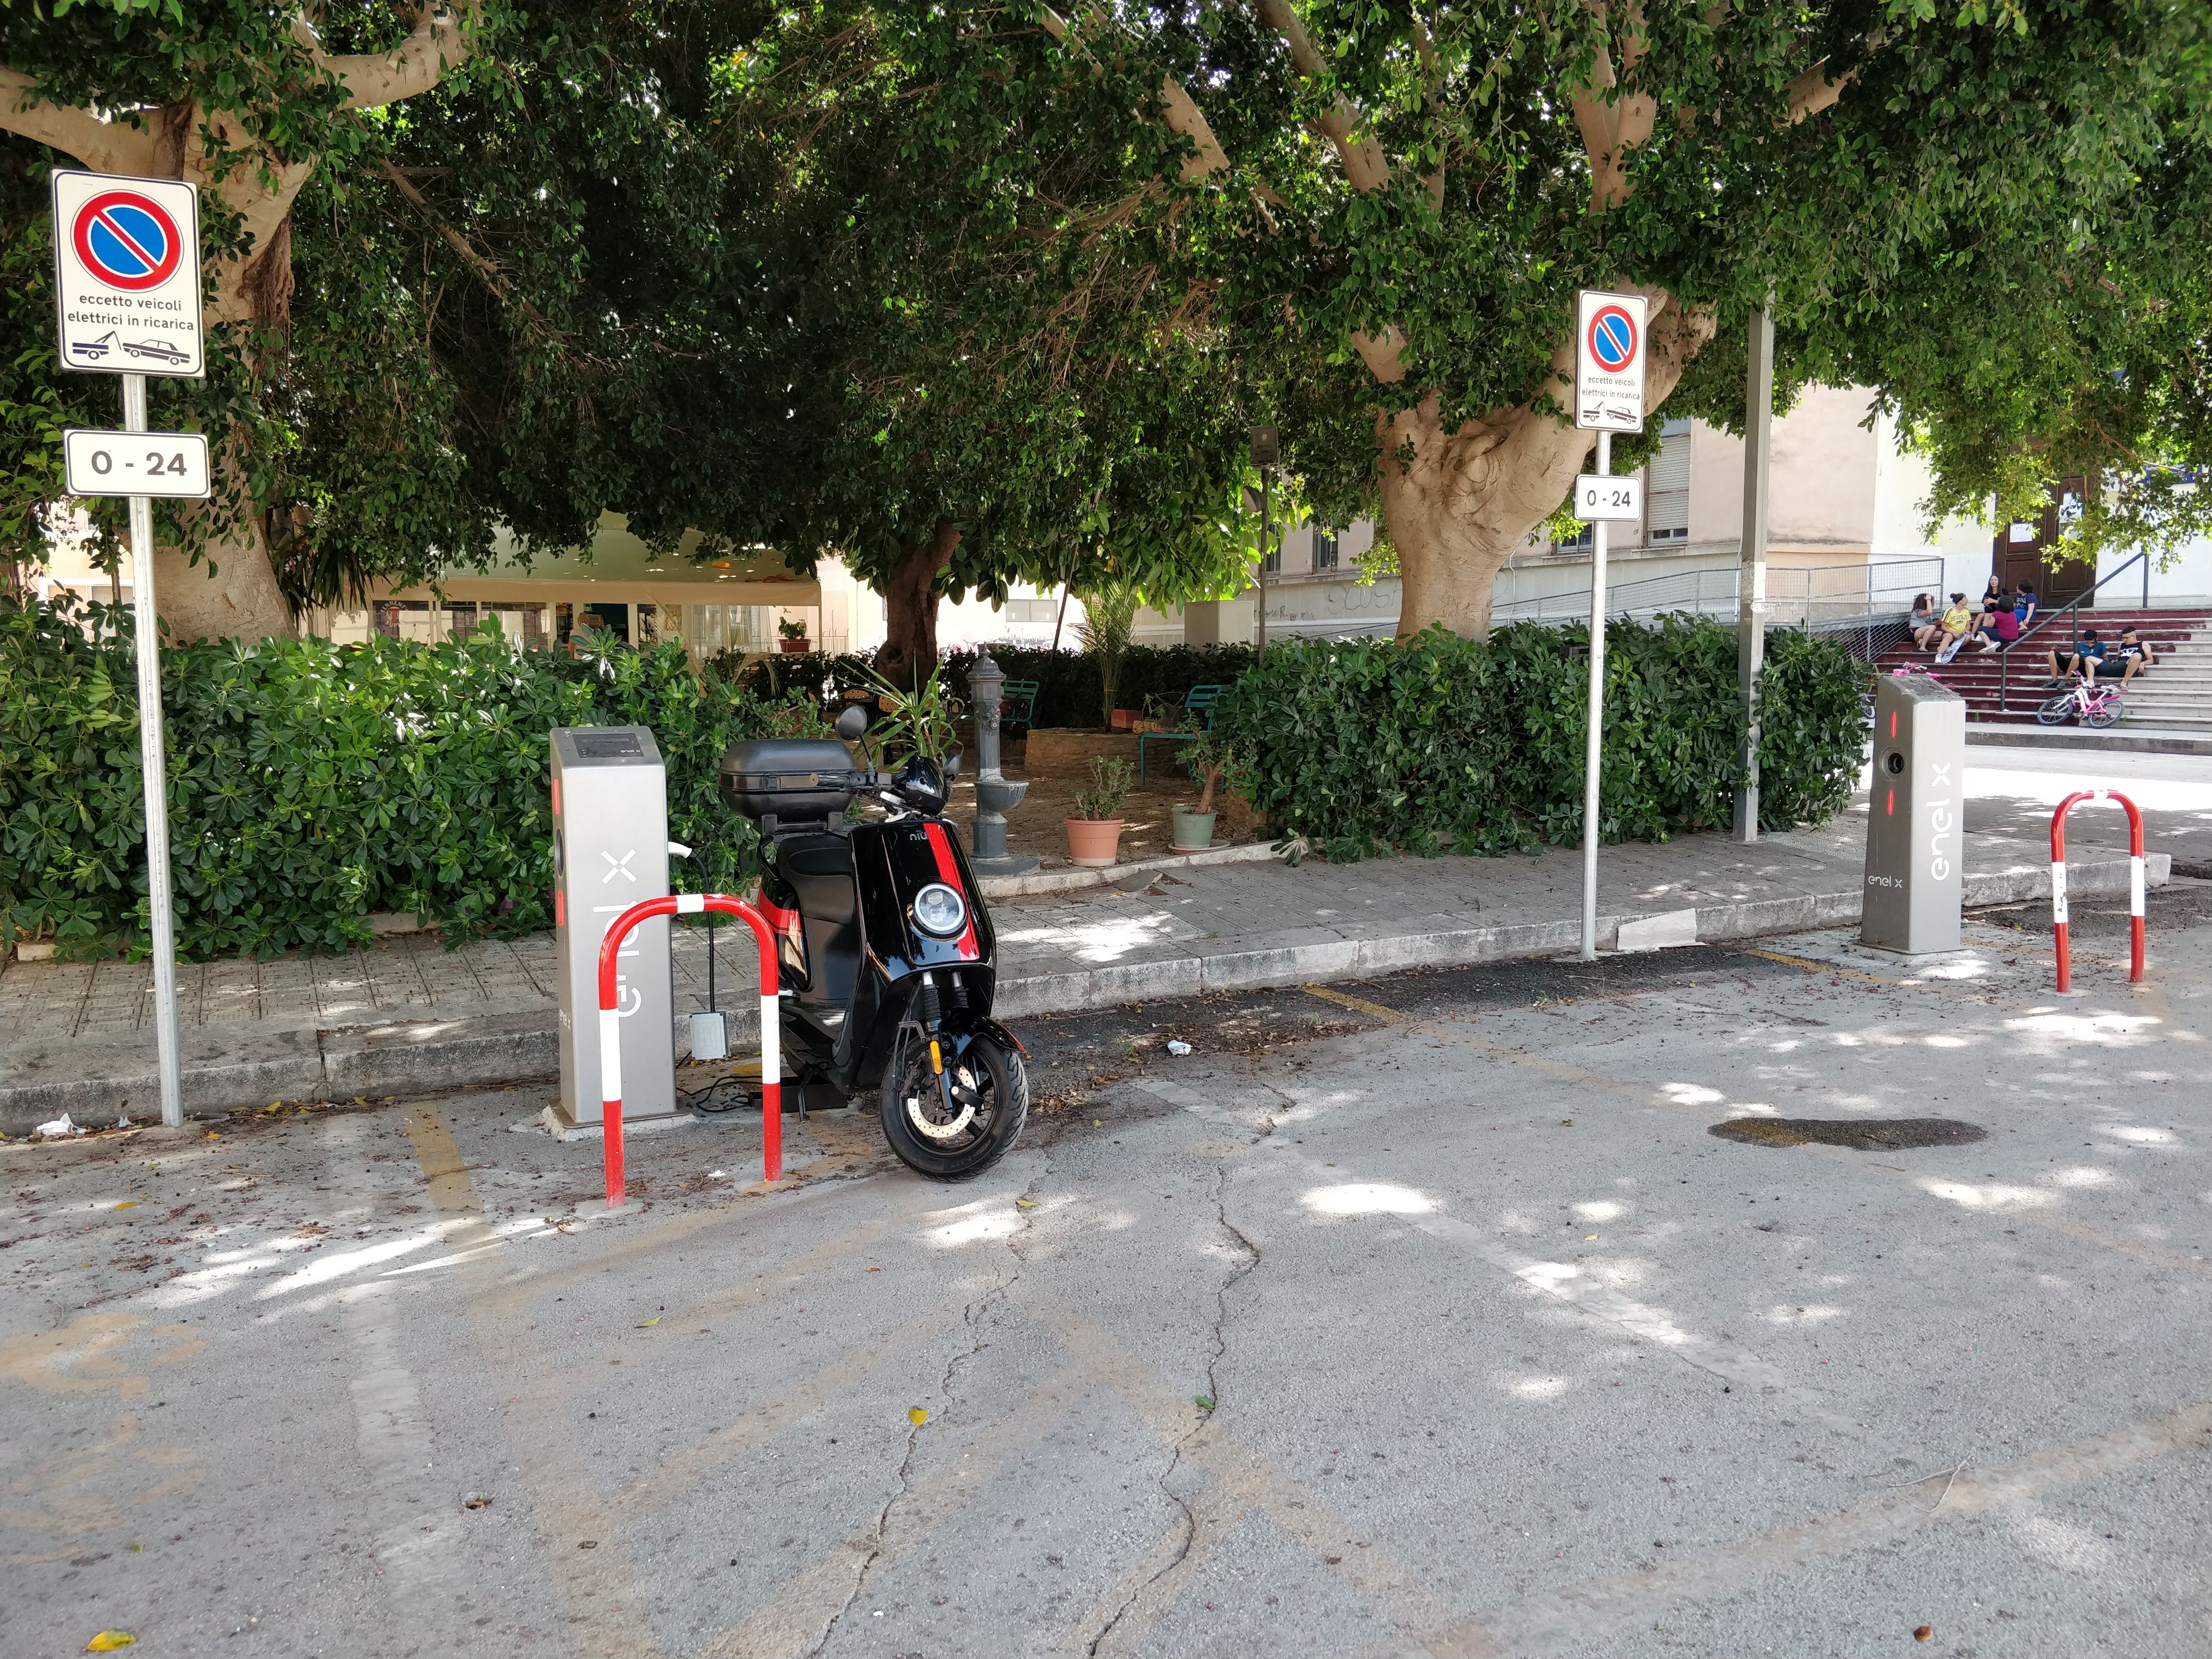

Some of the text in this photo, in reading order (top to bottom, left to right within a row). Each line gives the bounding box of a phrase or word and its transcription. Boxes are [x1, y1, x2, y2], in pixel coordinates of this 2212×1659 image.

[80, 295, 181, 311] eccetto veicoli
[68, 311, 194, 330] elettrici in ricarica
[1582, 388, 1607, 397] elettrici
[1617, 391, 1640, 399] ricarica
[91, 451, 112, 475] 0
[146, 453, 187, 476] 24
[1587, 490, 1597, 506] 0
[1612, 491, 1631, 507] 24
[1926, 798, 1952, 881] enel
[1868, 876, 1902, 888] enel x
